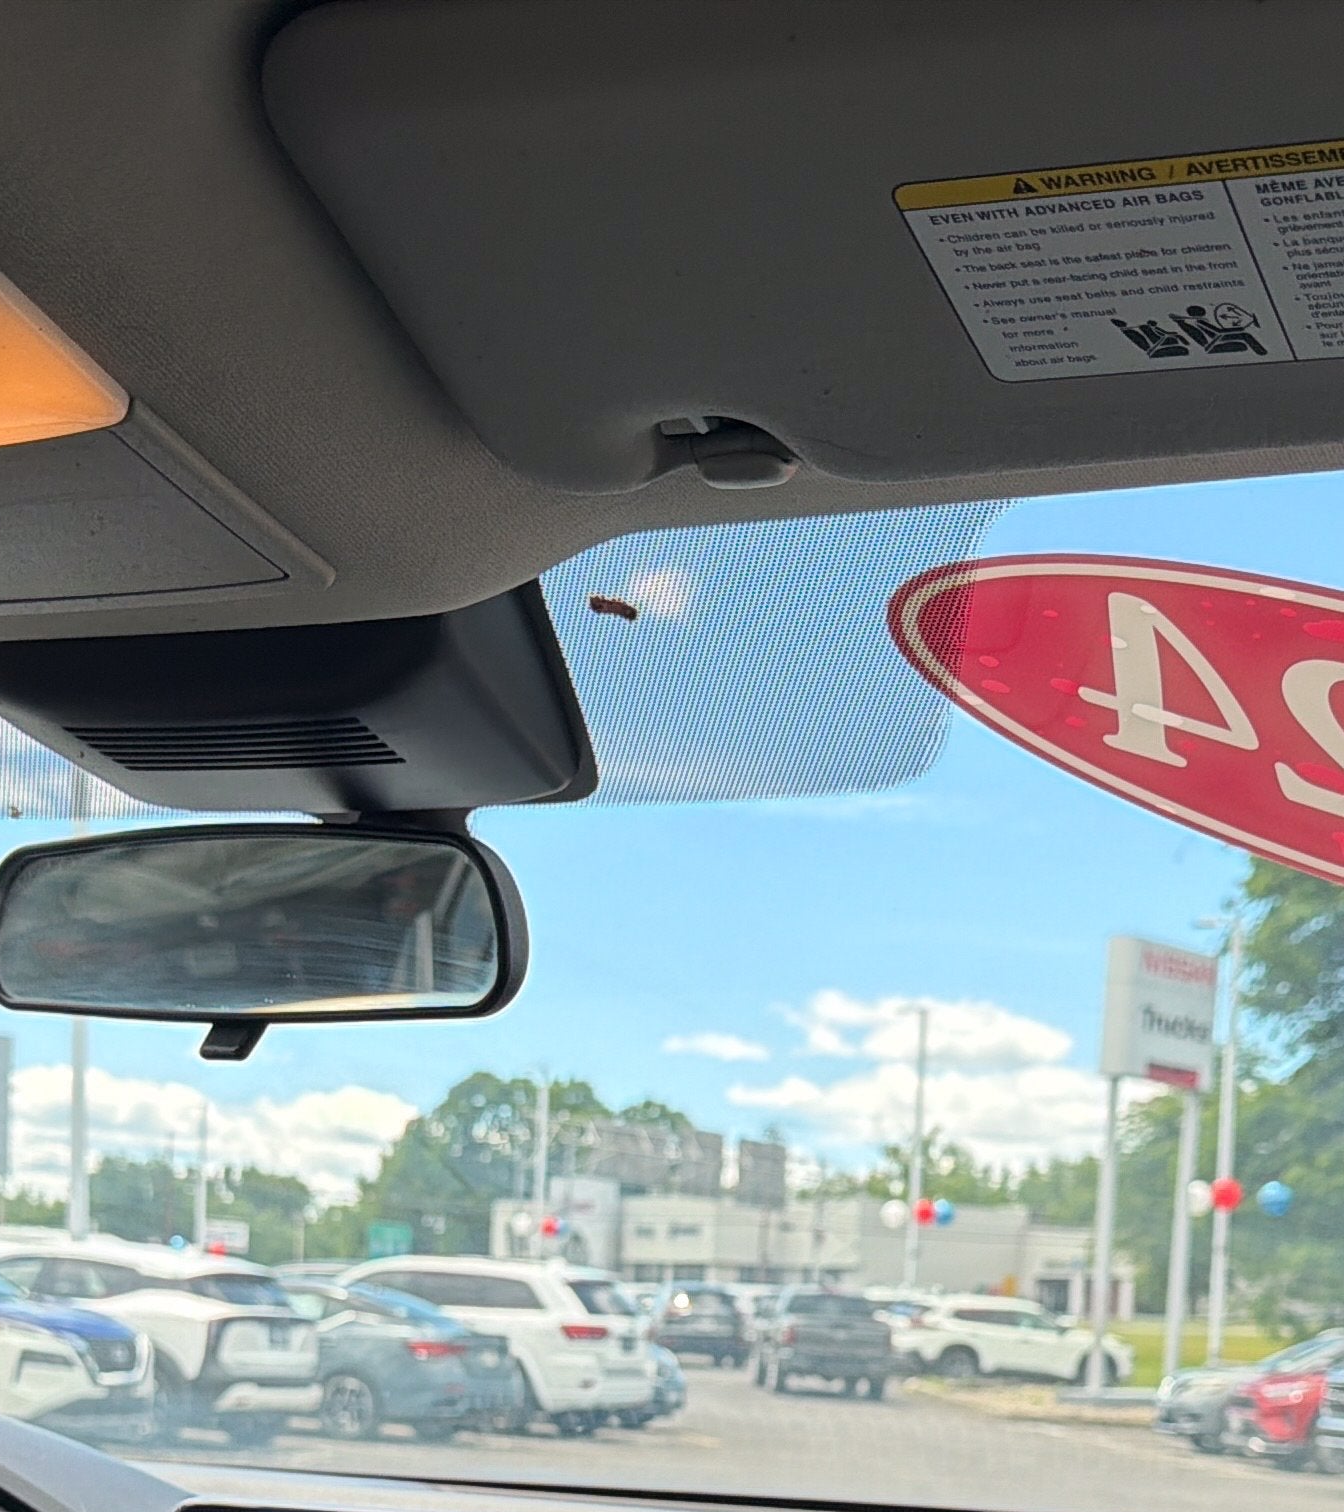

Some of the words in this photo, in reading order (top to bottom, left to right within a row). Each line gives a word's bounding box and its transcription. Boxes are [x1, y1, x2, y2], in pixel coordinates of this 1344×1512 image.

[1039, 166, 1156, 191] WARNING
[1256, 178, 1308, 194] MÊME
[930, 209, 973, 225] EVEN
[976, 206, 1017, 221] WITH
[1025, 199, 1115, 217] ADVANCED
[1122, 196, 1150, 207] AIR
[1156, 190, 1204, 203] BAGS
[947, 230, 1000, 243] Children
[1005, 230, 1027, 239] can
[1031, 227, 1046, 237] be
[1050, 222, 1084, 235] killed
[1089, 223, 1101, 231] or
[1106, 215, 1165, 229] seriously
[1169, 211, 1215, 224] injured
